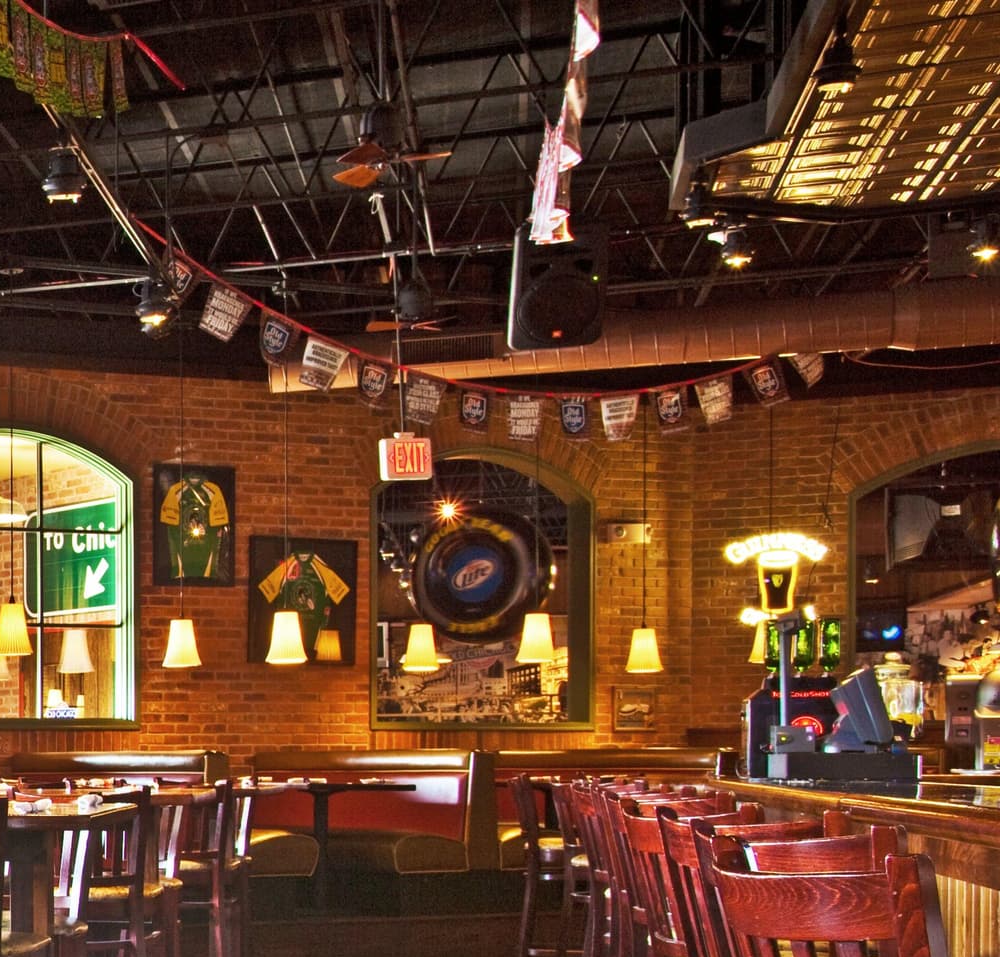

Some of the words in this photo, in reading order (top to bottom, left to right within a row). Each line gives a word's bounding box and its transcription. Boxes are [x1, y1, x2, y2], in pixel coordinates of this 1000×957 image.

[367, 370, 382, 381] Old
[467, 397, 481, 407] Old
[395, 442, 425, 473] EXIT
[462, 564, 490, 588] Lite
